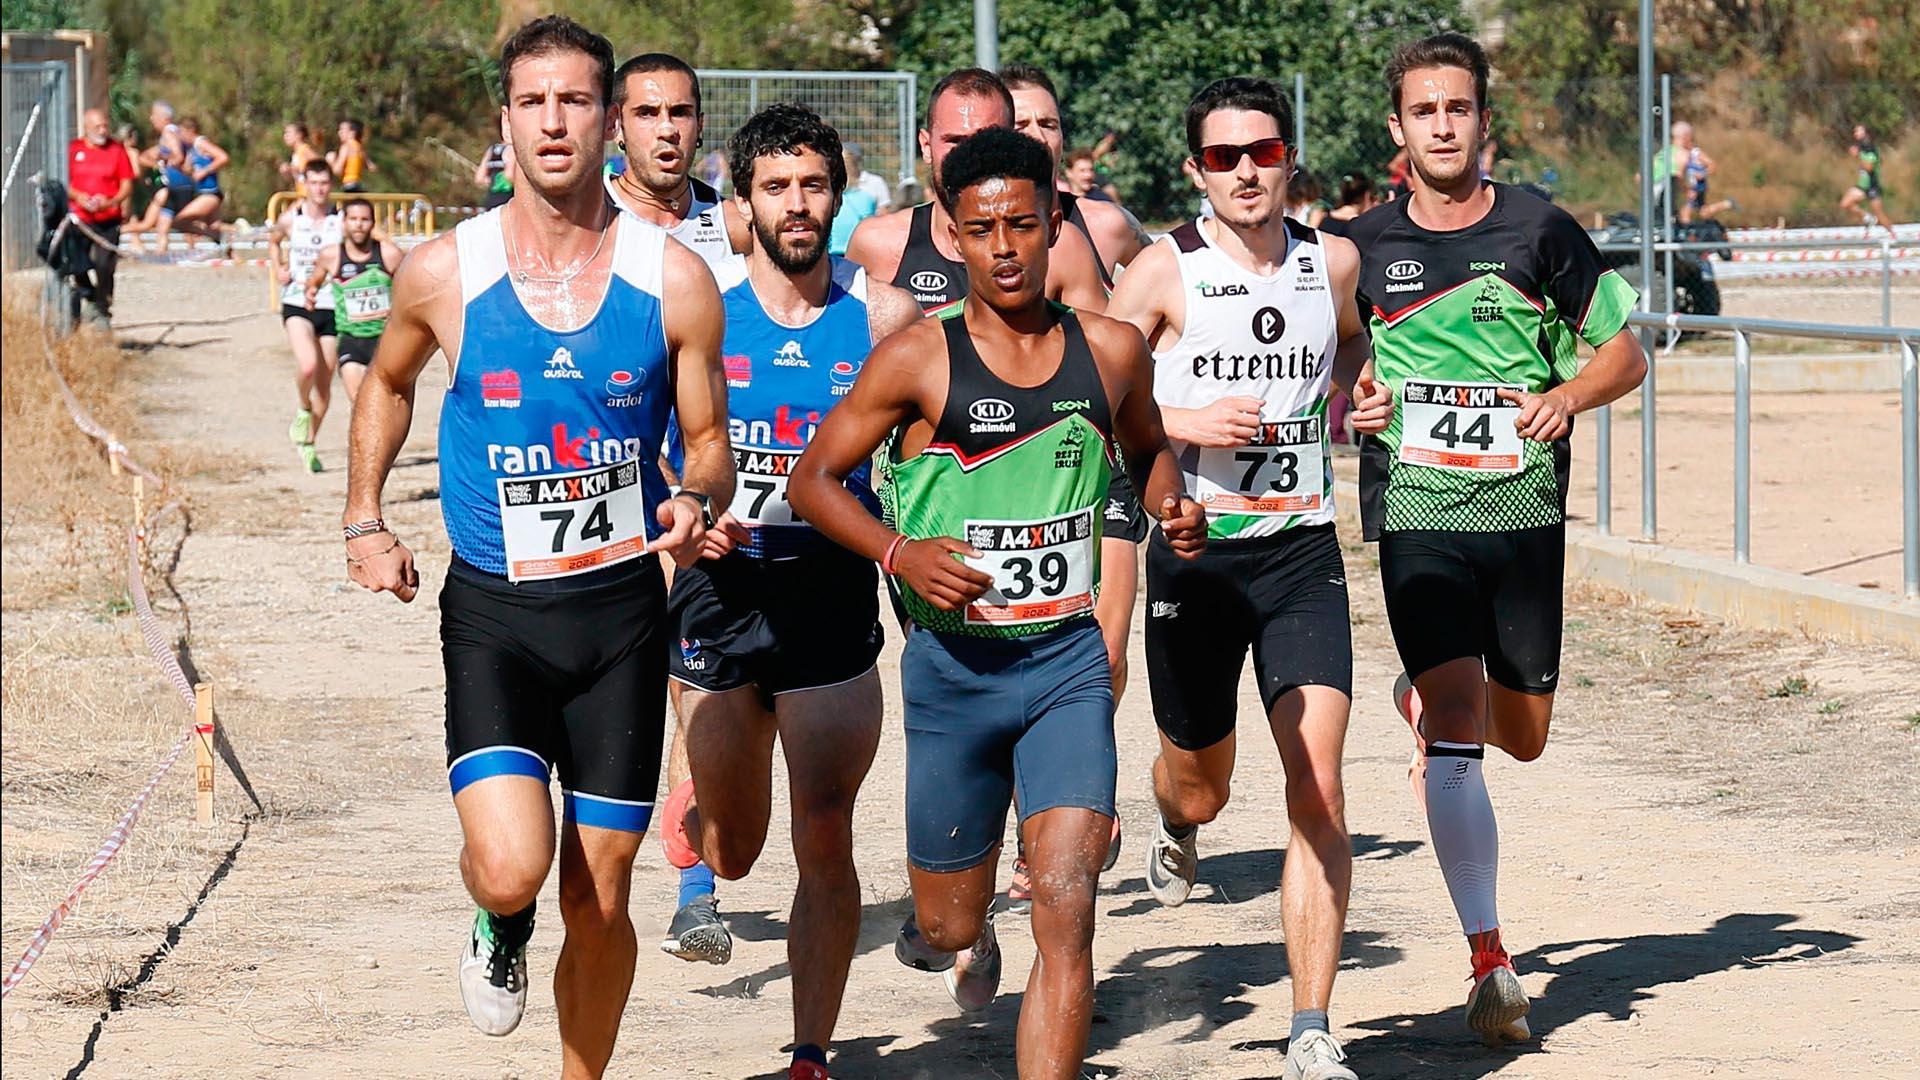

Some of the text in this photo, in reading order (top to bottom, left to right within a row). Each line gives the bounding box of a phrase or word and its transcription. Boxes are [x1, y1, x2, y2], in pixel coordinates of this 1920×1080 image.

[1392, 264, 1418, 276] KIA
[917, 276, 941, 287] KIA
[1385, 281, 1424, 293] Sakimóvil
[357, 297, 380, 312] 76
[607, 392, 643, 408] ardoi
[1431, 386, 1496, 407] A4XKM
[977, 403, 1008, 417] KIA
[969, 421, 1016, 434] Sakimóvil
[1251, 423, 1302, 445] 4XKM
[1430, 411, 1494, 451] 44
[1235, 451, 1299, 493] 73
[538, 471, 610, 503] A4XKM
[1252, 502, 1279, 511] 2022
[540, 499, 614, 553] 74
[1000, 520, 1069, 549] A4XKM
[569, 556, 597, 570] 2022
[1000, 551, 1069, 600] 39
[1022, 607, 1051, 619] 2022
